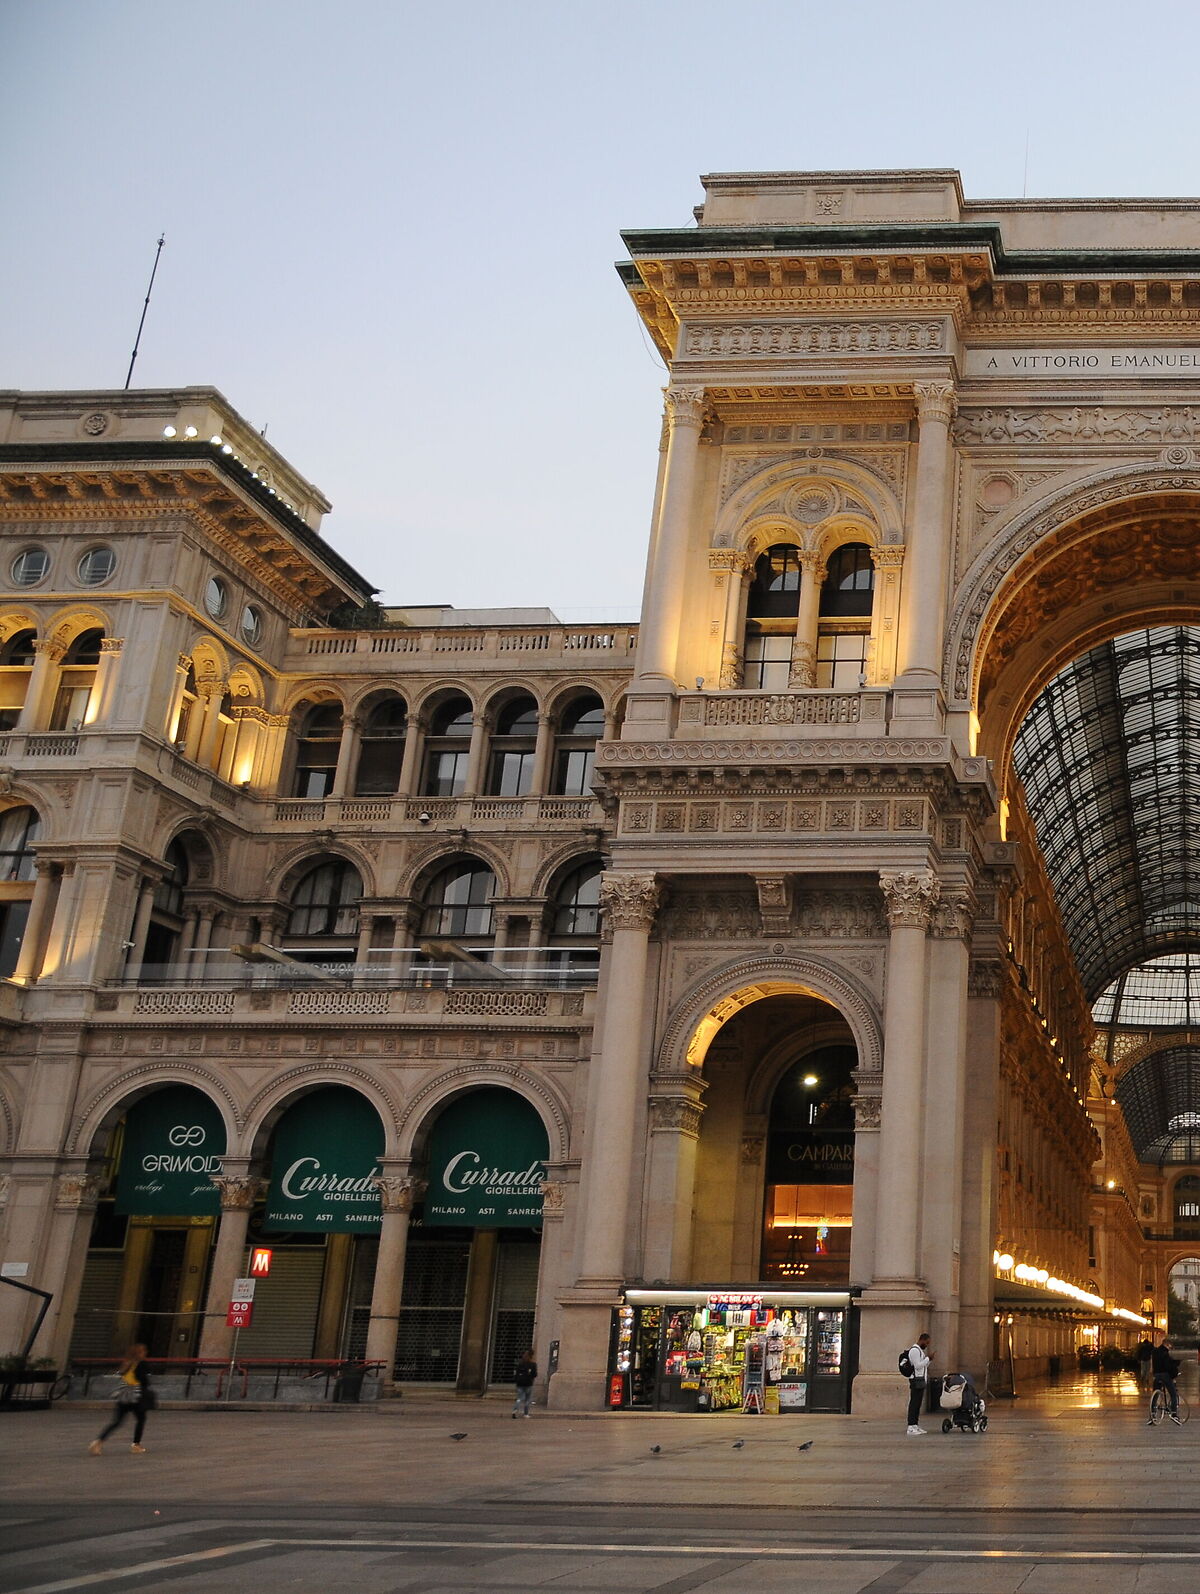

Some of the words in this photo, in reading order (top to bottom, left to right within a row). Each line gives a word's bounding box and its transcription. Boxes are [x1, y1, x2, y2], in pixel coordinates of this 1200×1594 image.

[987, 356, 998, 368] A
[1012, 355, 1100, 368] VITTORIO
[787, 1143, 853, 1161] CAMPAR
[485, 1186, 544, 1195] GIOIELLERIE
[323, 1193, 380, 1202] GIOIELLERIE
[431, 1206, 466, 1214] MILANO
[478, 1207, 495, 1215] ASTI
[507, 1208, 542, 1216] SANREM
[269, 1213, 304, 1221] MILANO
[315, 1213, 333, 1222] ASTI
[253, 1253, 269, 1272] M
